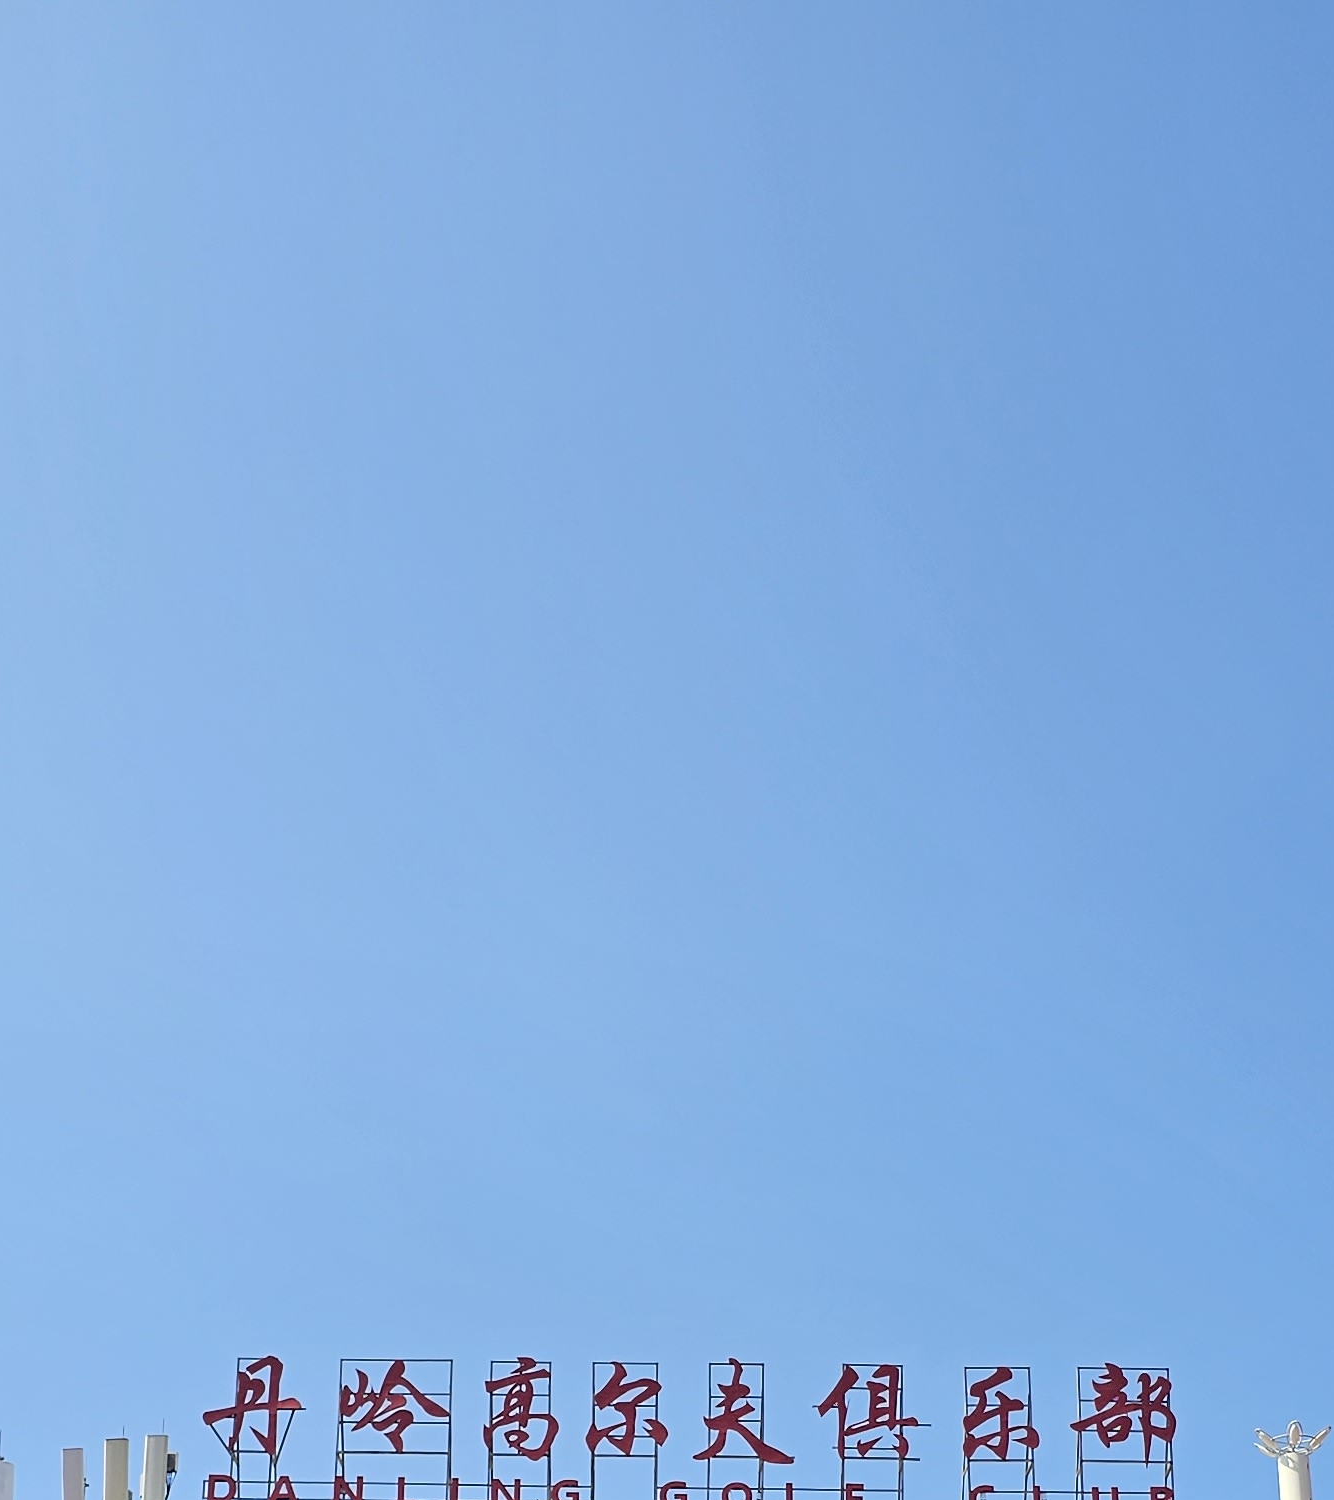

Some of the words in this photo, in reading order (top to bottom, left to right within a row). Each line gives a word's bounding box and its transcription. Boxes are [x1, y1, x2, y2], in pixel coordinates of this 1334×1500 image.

[203, 1355, 1176, 1465] 丹岭高尔夫俱乐部
